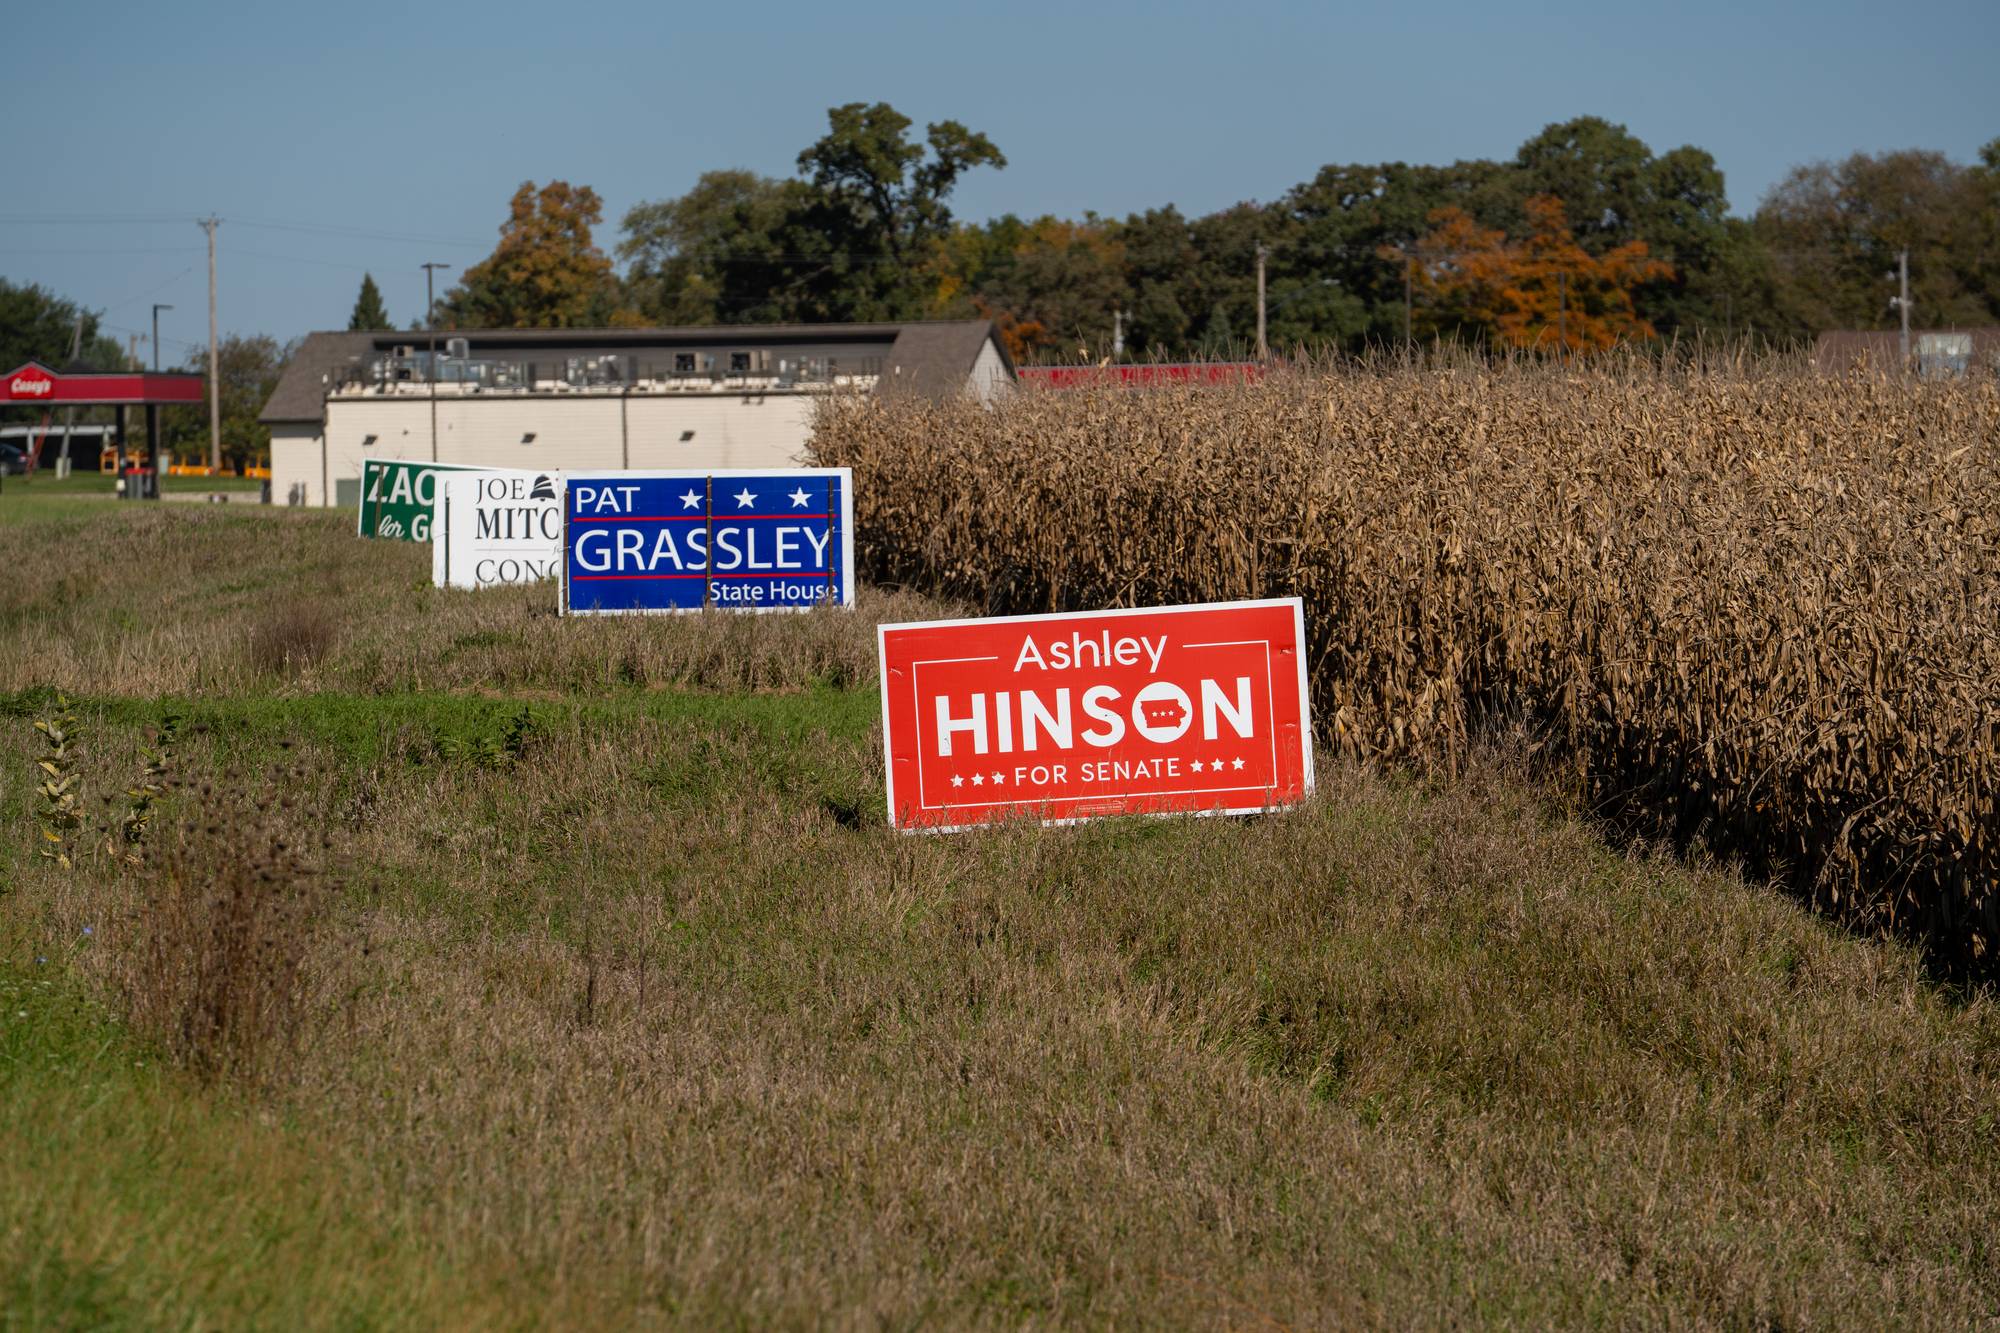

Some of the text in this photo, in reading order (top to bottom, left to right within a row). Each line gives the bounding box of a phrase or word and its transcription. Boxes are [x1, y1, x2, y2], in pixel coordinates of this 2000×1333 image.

[476, 478, 526, 505] JOE
[575, 486, 641, 513] PAT
[411, 514, 436, 543] G
[575, 526, 834, 572] GRASSLEY
[709, 580, 839, 601] State House
[1013, 629, 1168, 674] Ashley
[935, 676, 1254, 758] HINSON
[1014, 757, 1182, 787] FOR SENATE
